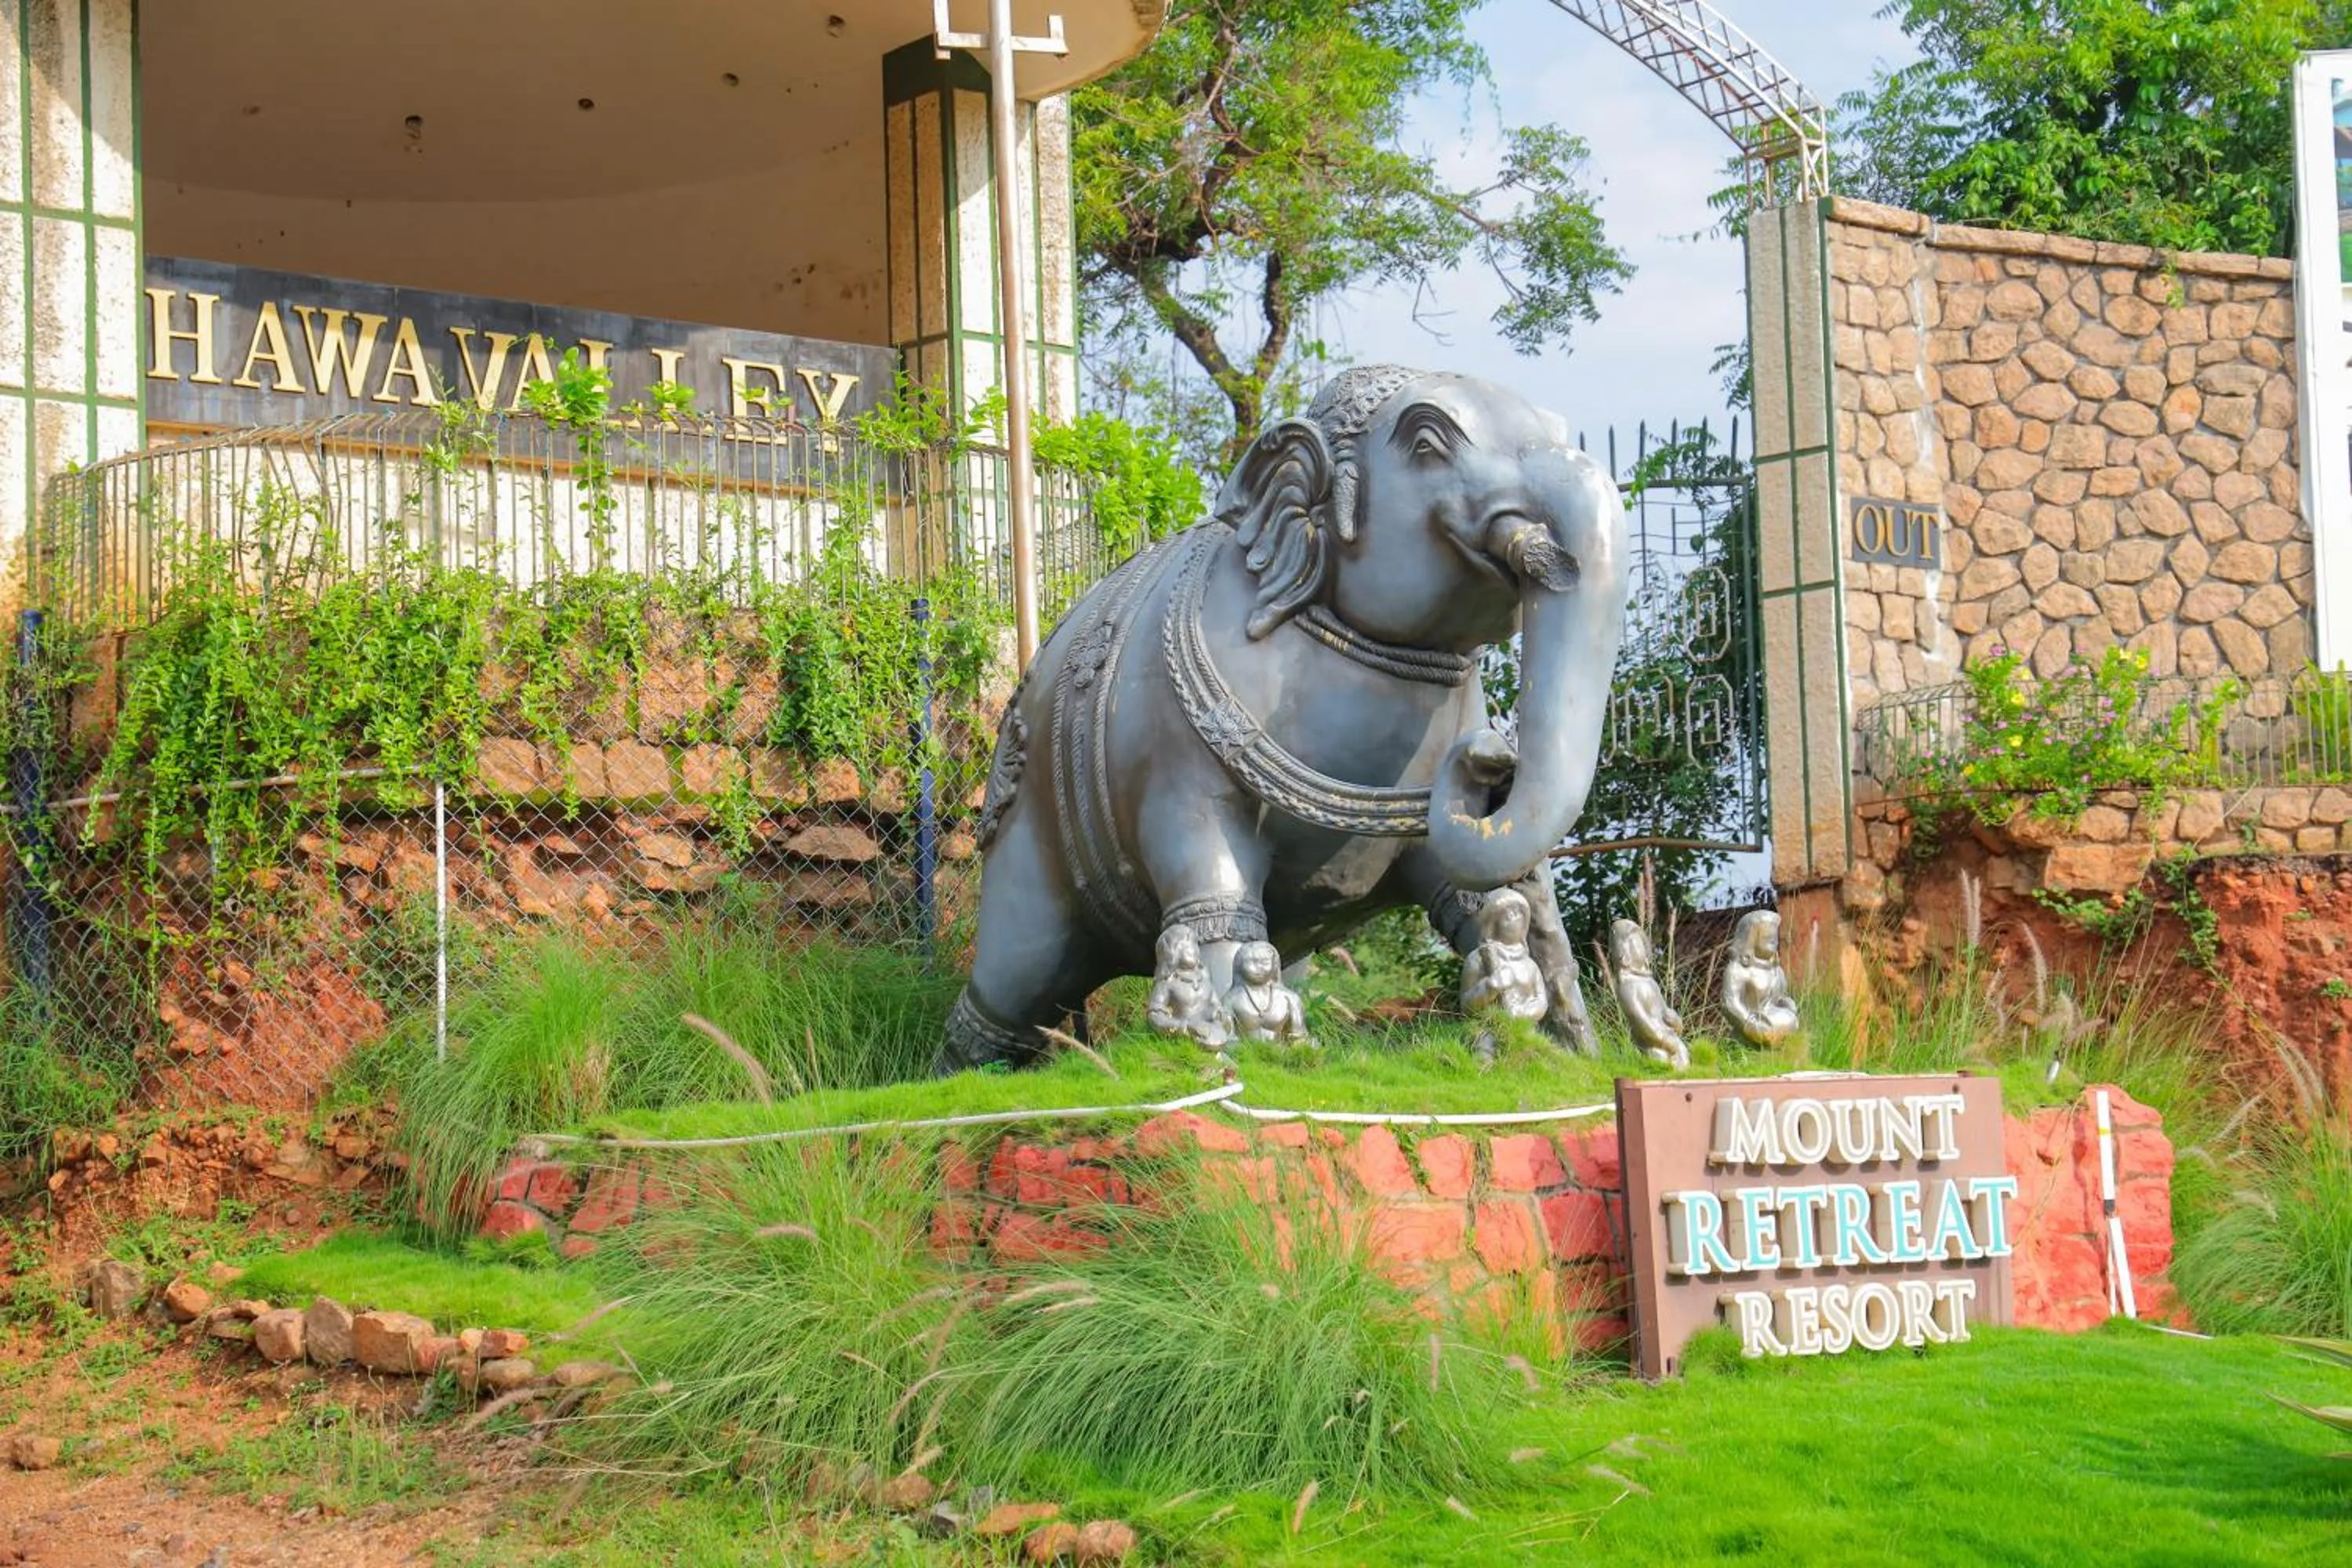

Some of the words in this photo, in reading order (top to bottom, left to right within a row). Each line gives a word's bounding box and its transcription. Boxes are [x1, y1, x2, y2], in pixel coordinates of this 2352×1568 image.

[145, 287, 441, 408] HAWA
[1855, 503, 1939, 561] OUT
[1726, 1094, 1965, 1165] MOUNT
[1679, 1176, 2017, 1276] RETREAT
[1735, 1279, 1976, 1358] RESORT
